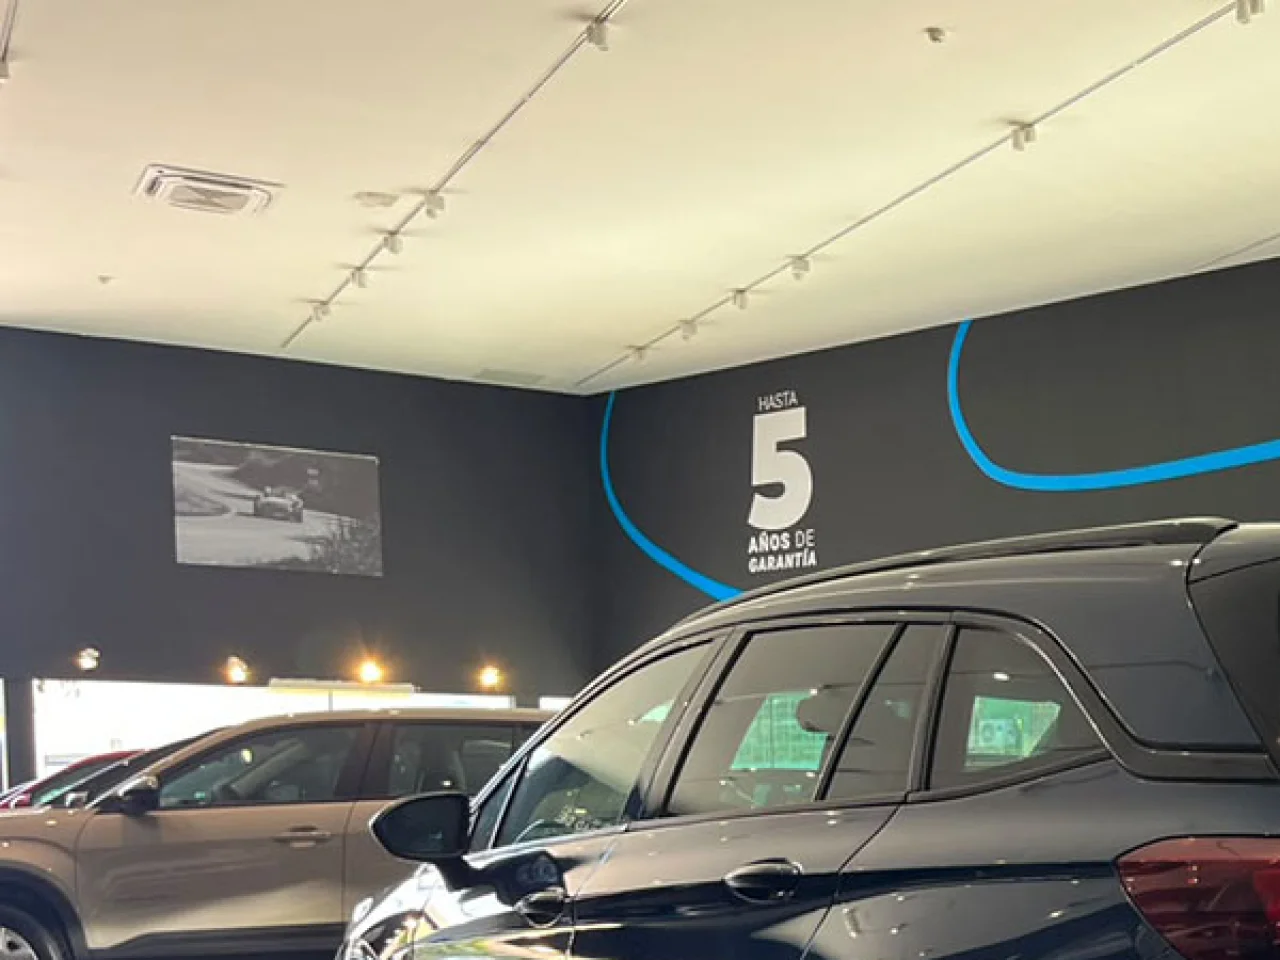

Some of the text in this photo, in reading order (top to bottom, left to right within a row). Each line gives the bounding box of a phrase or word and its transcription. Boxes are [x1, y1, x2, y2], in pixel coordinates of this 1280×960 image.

[757, 391, 799, 411] HASTA
[748, 406, 812, 530] 5
[748, 529, 816, 554] AÑOS DE
[748, 548, 817, 573] GARANTÍA
